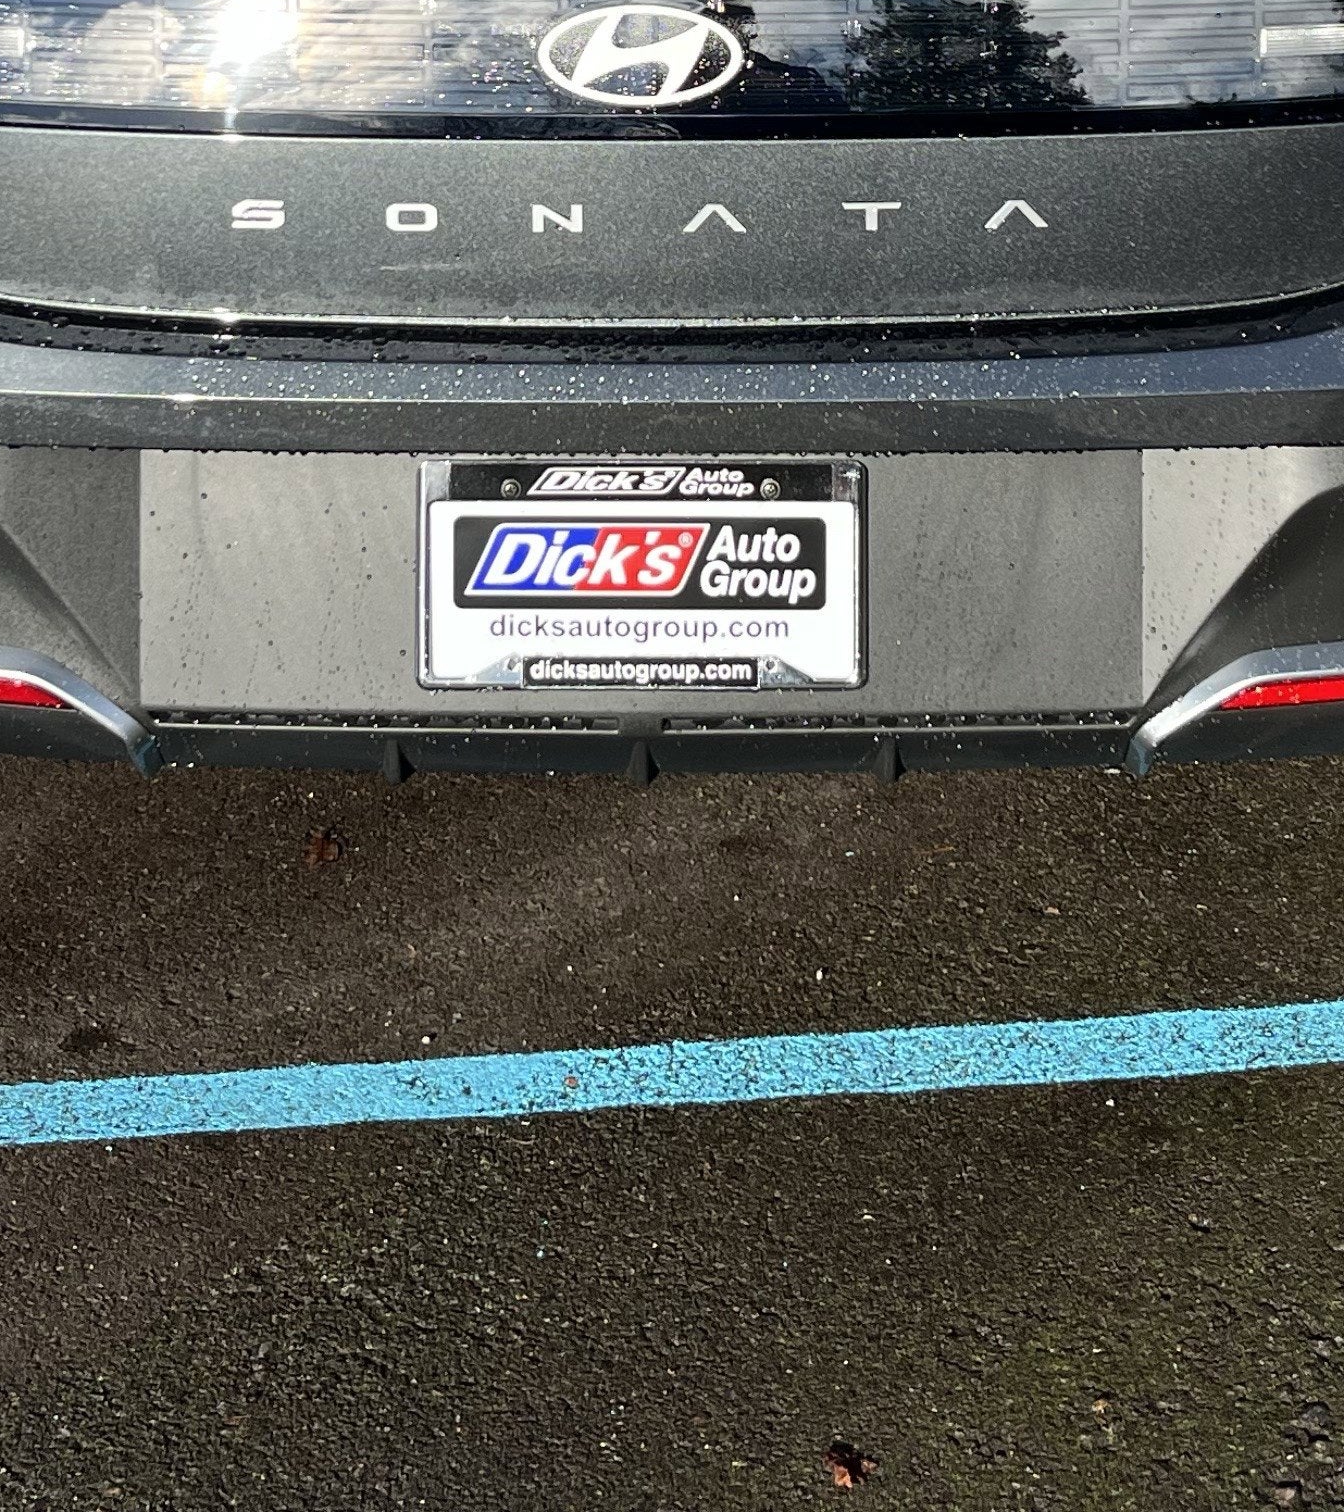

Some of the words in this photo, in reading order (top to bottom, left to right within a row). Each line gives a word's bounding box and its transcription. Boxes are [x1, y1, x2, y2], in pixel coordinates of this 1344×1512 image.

[231, 198, 1048, 234] SONATA
[679, 481, 755, 498] Group
[686, 467, 745, 483] Auto
[483, 530, 682, 586] Dick's
[706, 525, 800, 562] Auto
[700, 560, 816, 605] Group
[490, 614, 790, 643] dicksautogroup.com
[529, 659, 752, 684] dicksautogroup.com
